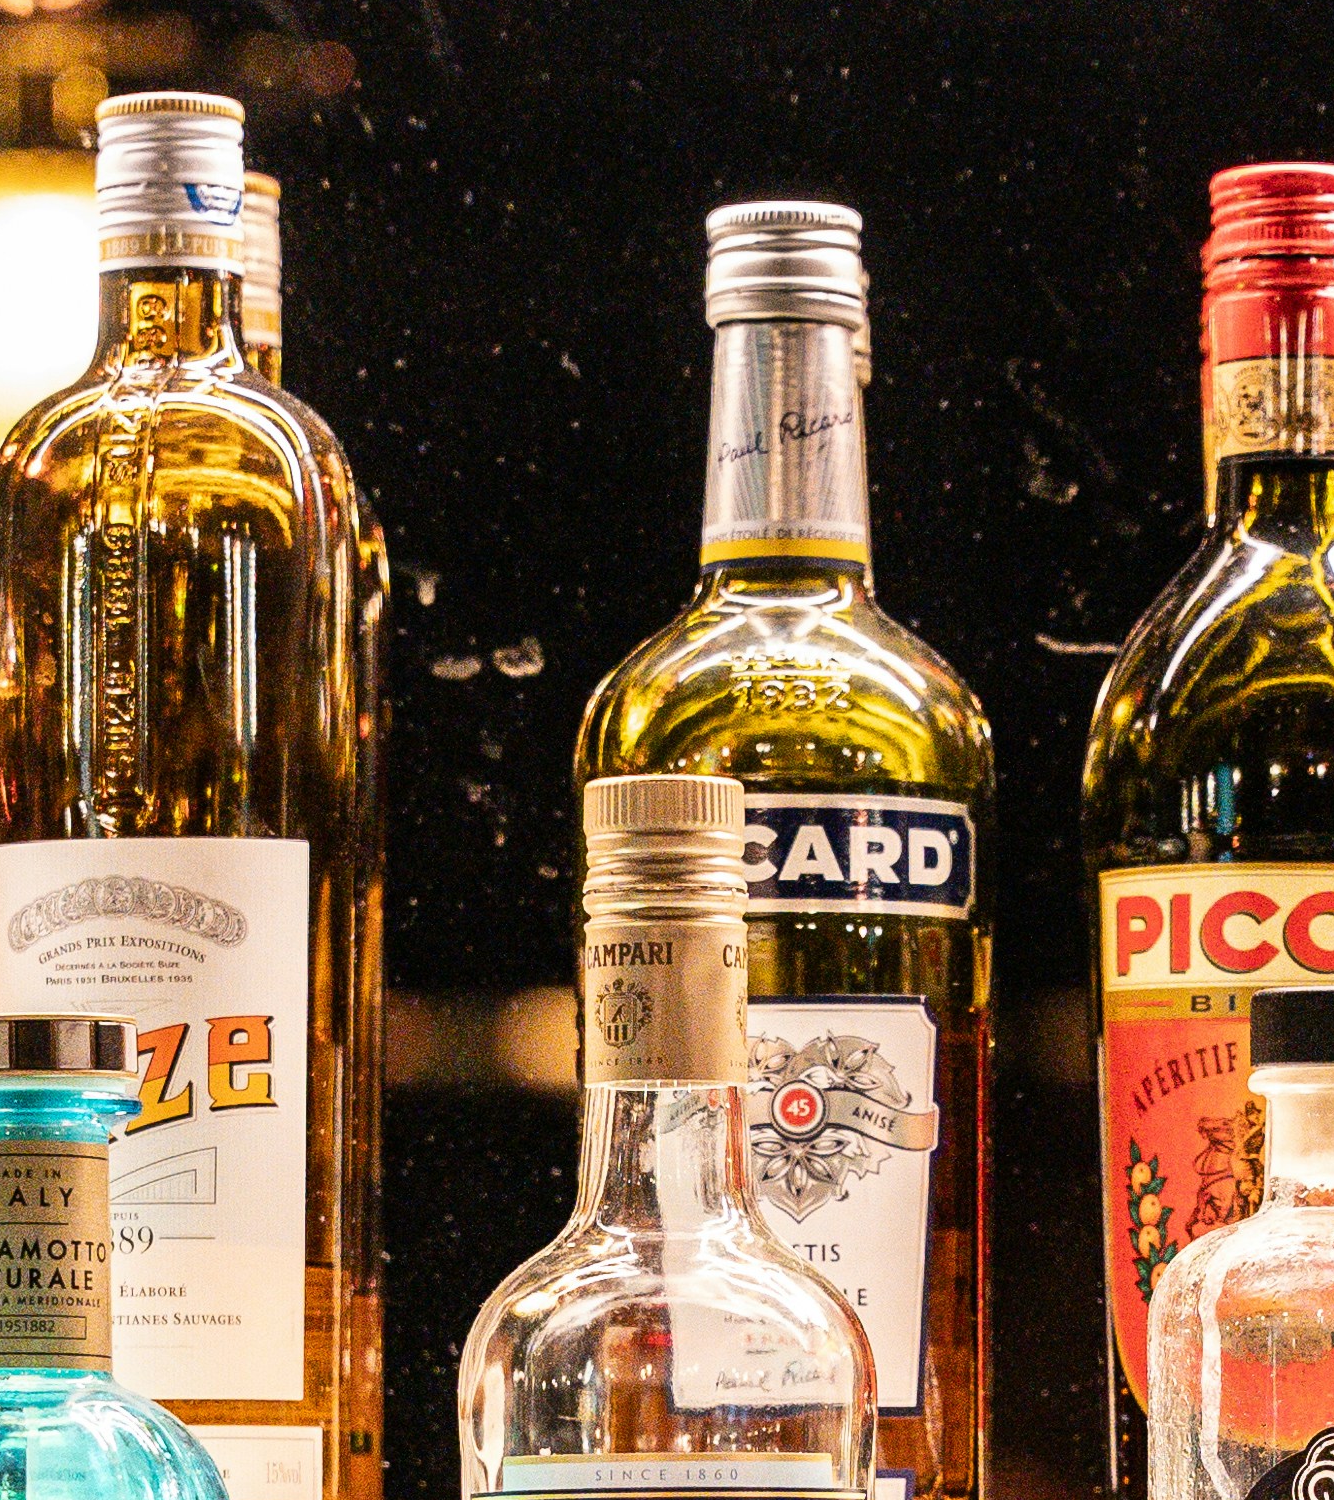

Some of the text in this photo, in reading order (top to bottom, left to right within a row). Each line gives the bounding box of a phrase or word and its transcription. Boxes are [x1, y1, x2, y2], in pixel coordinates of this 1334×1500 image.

[744, 824, 954, 886] CARD
[37, 934, 207, 966] GRANDS PRIX EXPOSITIONS
[587, 941, 675, 971] CAMPARI
[46, 976, 73, 986] PARIS
[101, 974, 164, 985] BRUXELLES
[1132, 1038, 1241, 1118] APÉRITIF
[785, 1099, 812, 1117] 45
[851, 1105, 899, 1134] ANISÉ
[45, 1169, 61, 1179] IN
[594, 1467, 740, 1483] SINCE 1860
